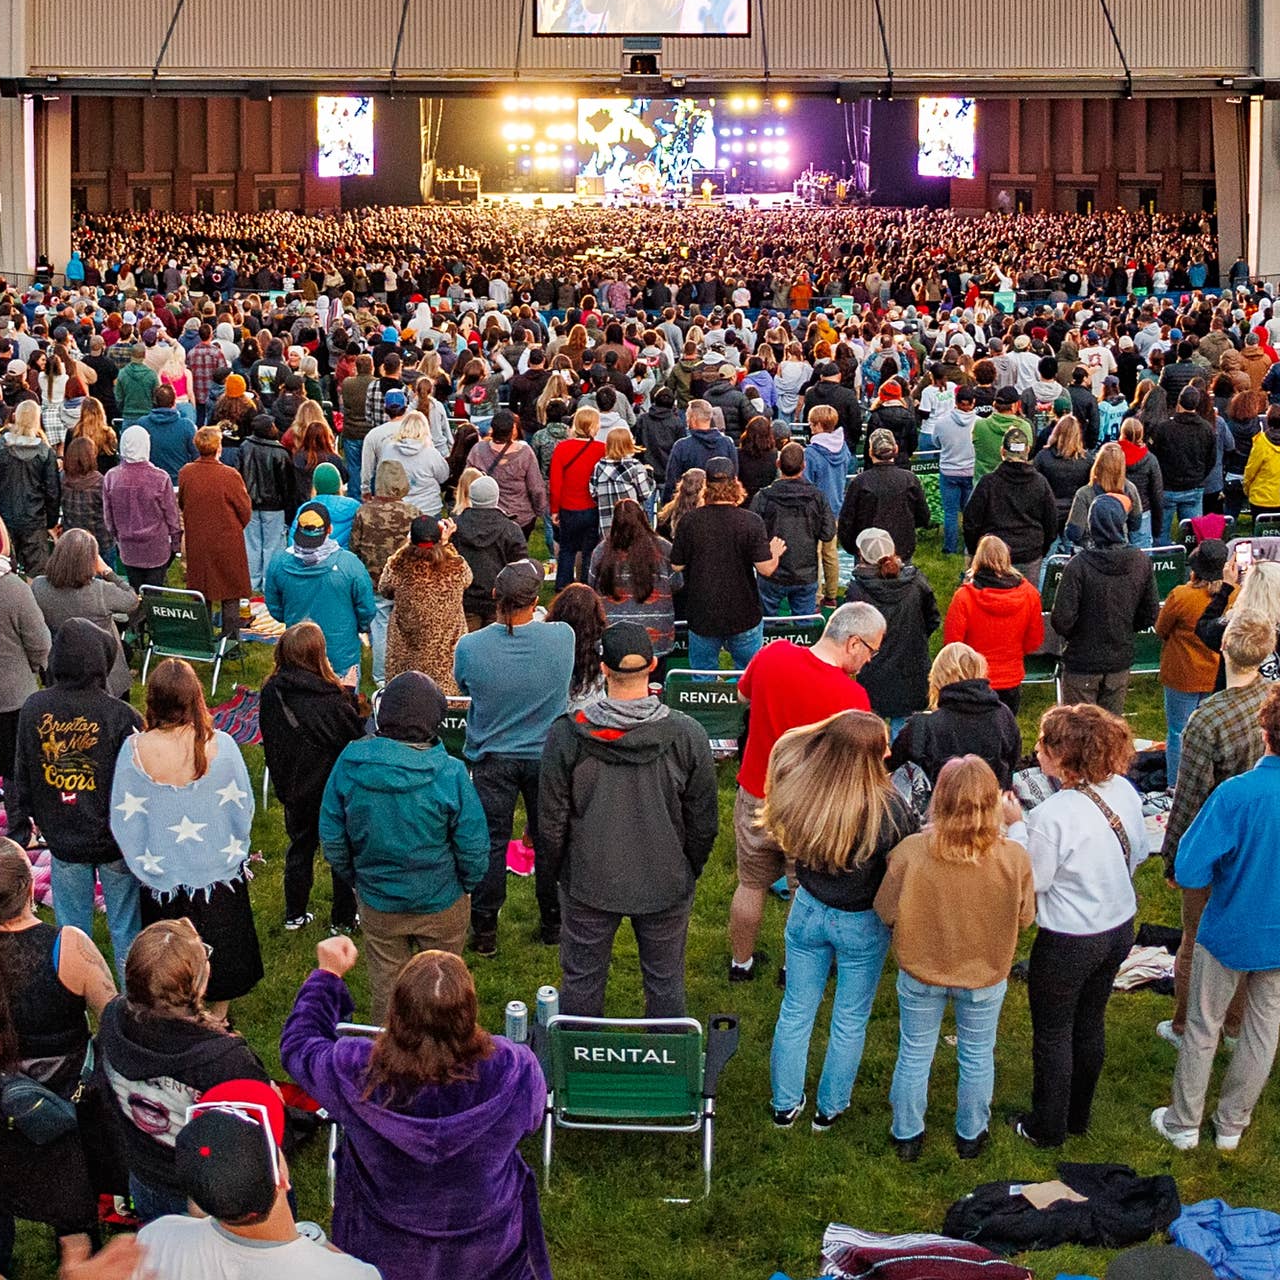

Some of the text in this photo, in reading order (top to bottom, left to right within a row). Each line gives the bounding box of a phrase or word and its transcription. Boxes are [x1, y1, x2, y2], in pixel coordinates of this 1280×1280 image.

[152, 605, 198, 621] RENTAL
[679, 691, 737, 704] RENTAL
[37, 713, 100, 739] Brixton
[42, 763, 97, 791] Coors
[573, 1046, 677, 1064] RENTAL
